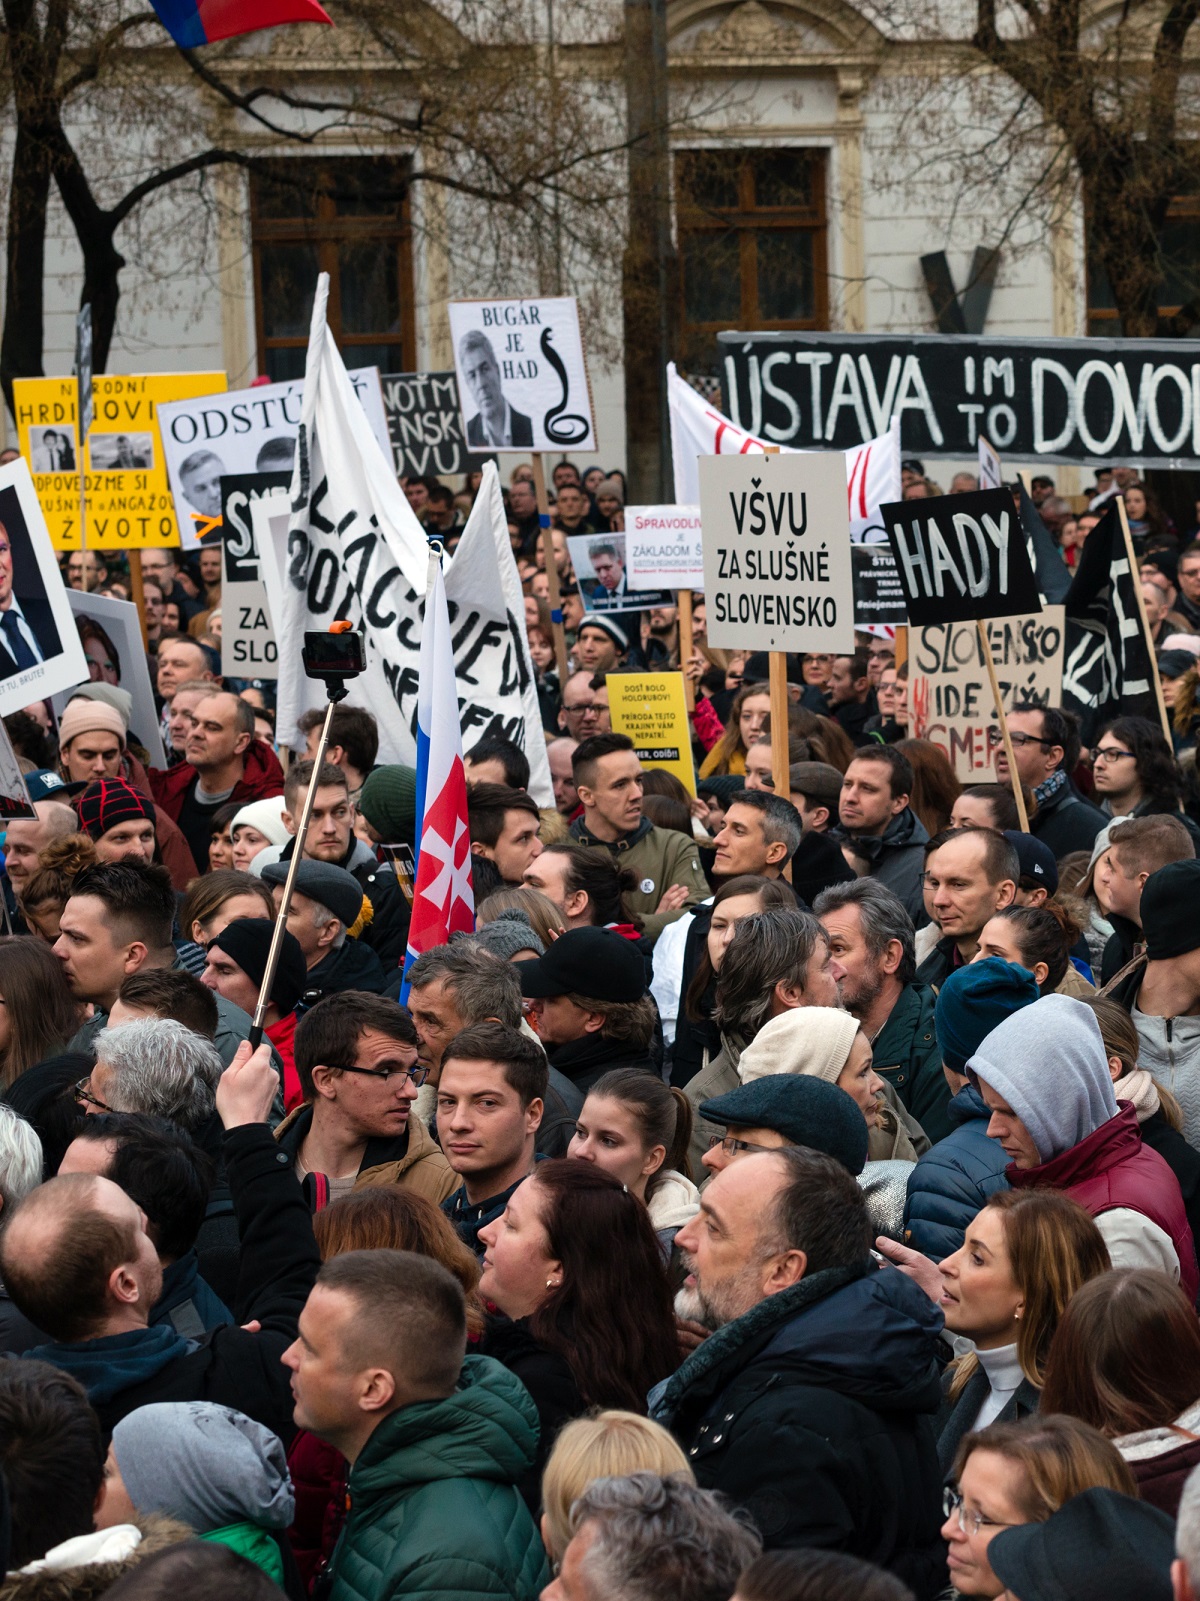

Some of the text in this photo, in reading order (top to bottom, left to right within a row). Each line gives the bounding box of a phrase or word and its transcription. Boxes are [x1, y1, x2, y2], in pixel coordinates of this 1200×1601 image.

[505, 333, 525, 353] JE
[61, 376, 148, 397] NRODNÍ
[503, 360, 539, 380] HAD
[963, 355, 1016, 398] IM
[723, 341, 944, 447] ÚSTAVA
[957, 402, 1018, 448] TO
[729, 476, 808, 537] VŠVU
[632, 544, 690, 558] ZÁKLADOM
[717, 540, 830, 583] ZA SLUŠNÉ
[893, 510, 1010, 599] HADY
[238, 607, 270, 631] ZA
[715, 592, 838, 628] SLOVENSKO
